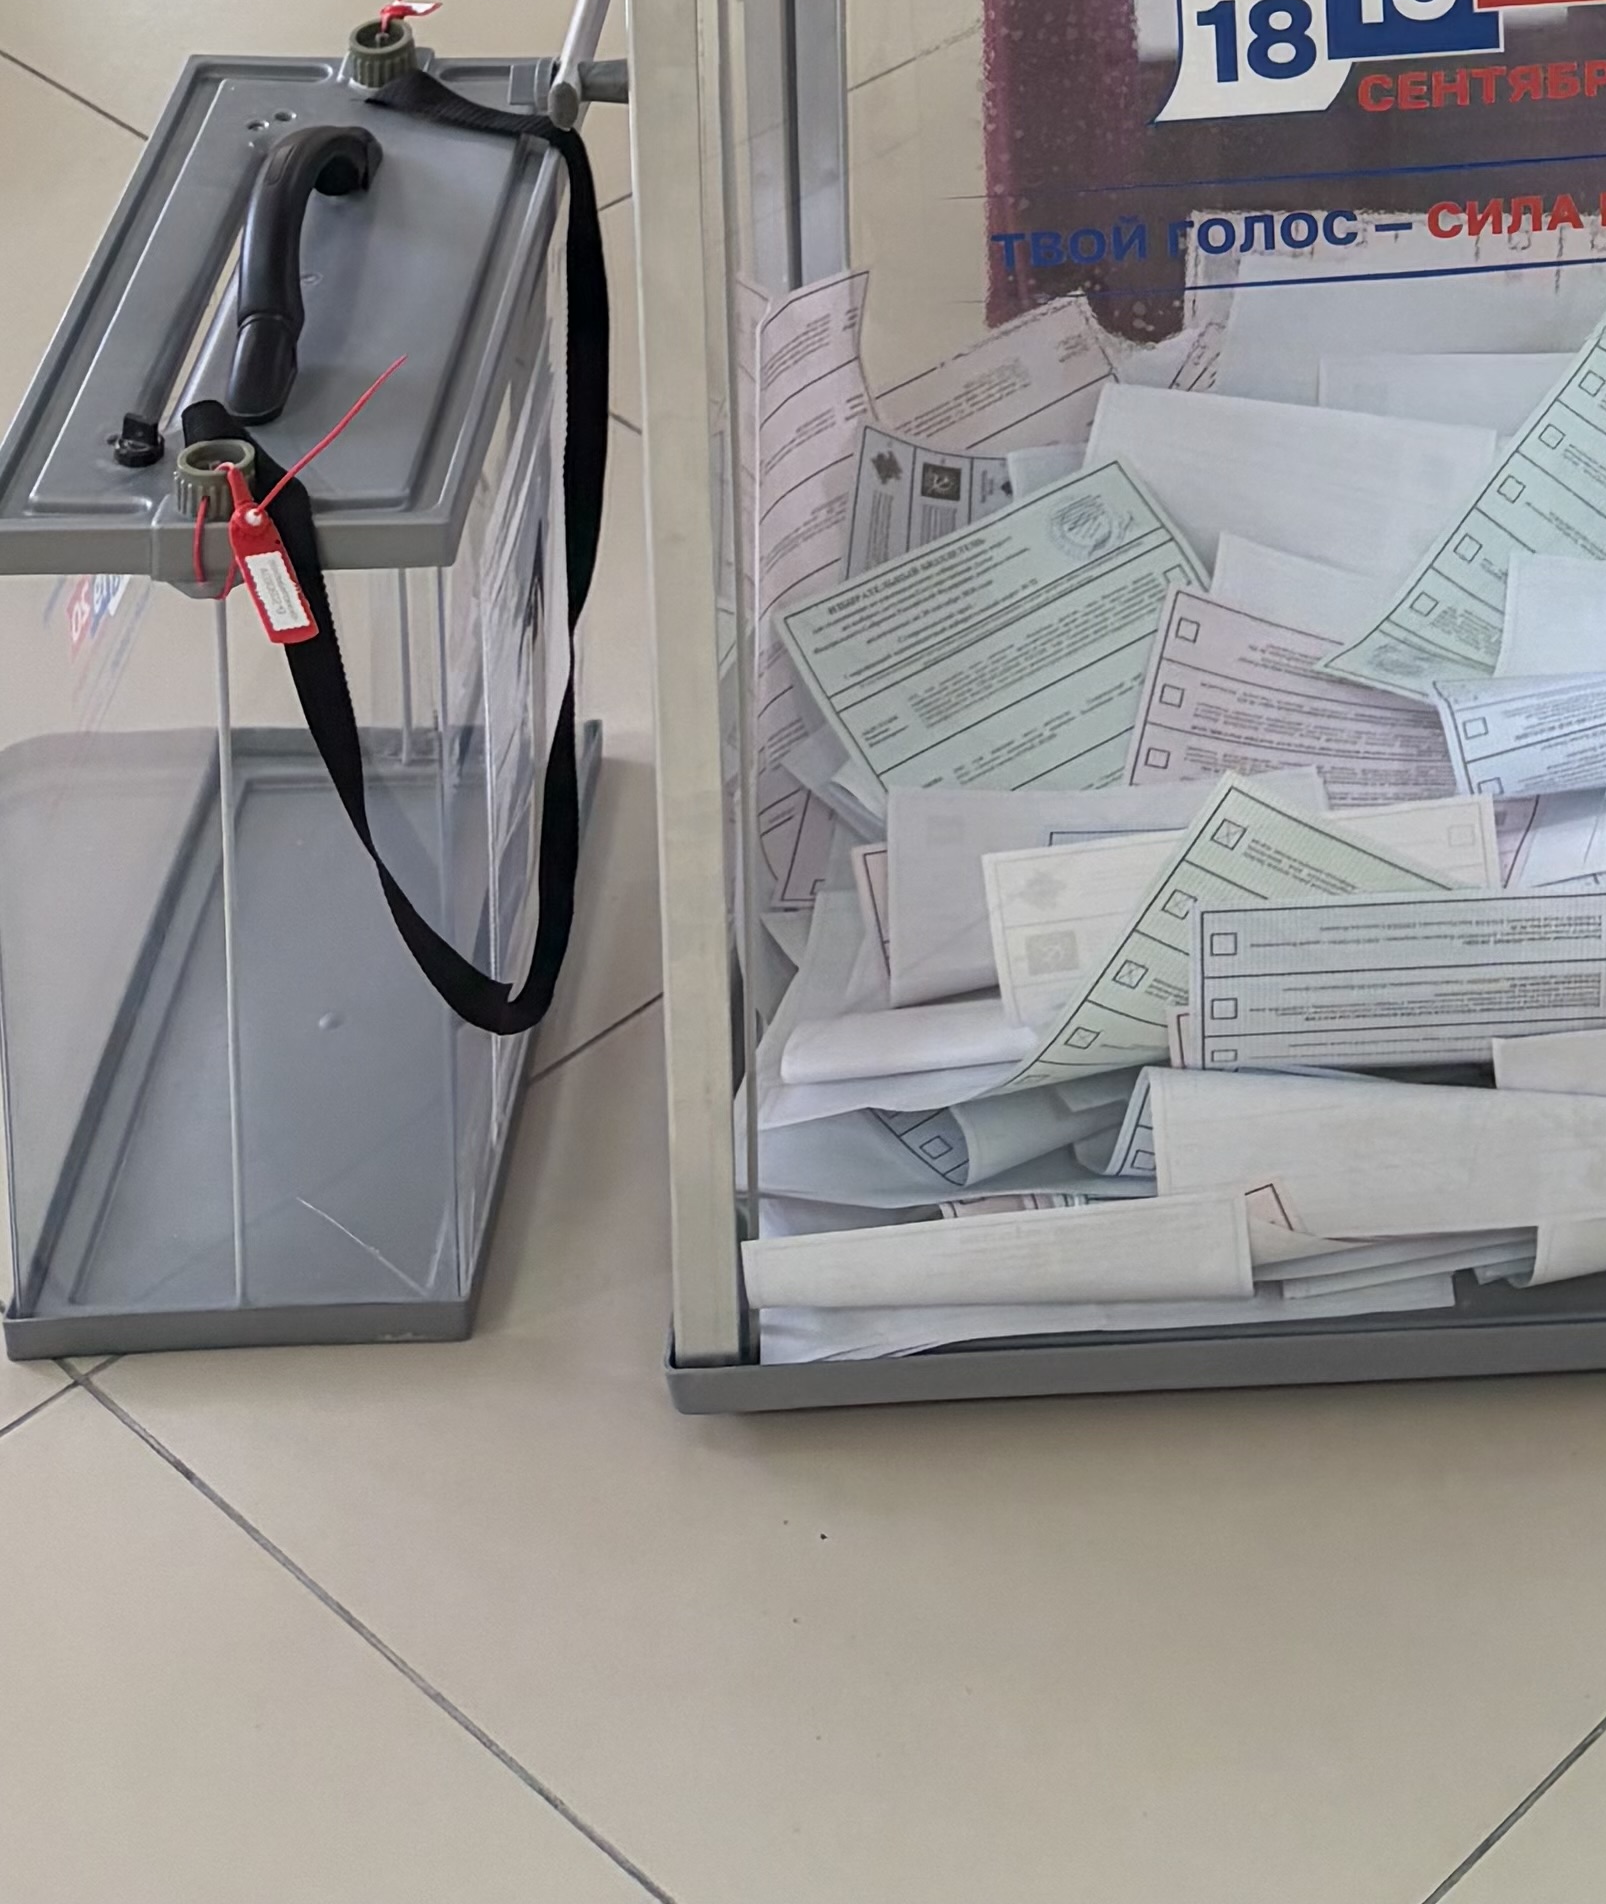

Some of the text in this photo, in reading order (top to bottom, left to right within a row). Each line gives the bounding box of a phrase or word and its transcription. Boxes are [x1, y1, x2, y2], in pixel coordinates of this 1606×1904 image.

[990, 215, 1149, 272] ТВОЙ
[1168, 210, 1359, 259] ГОЛОС
[1427, 193, 1585, 239] СИЛА
